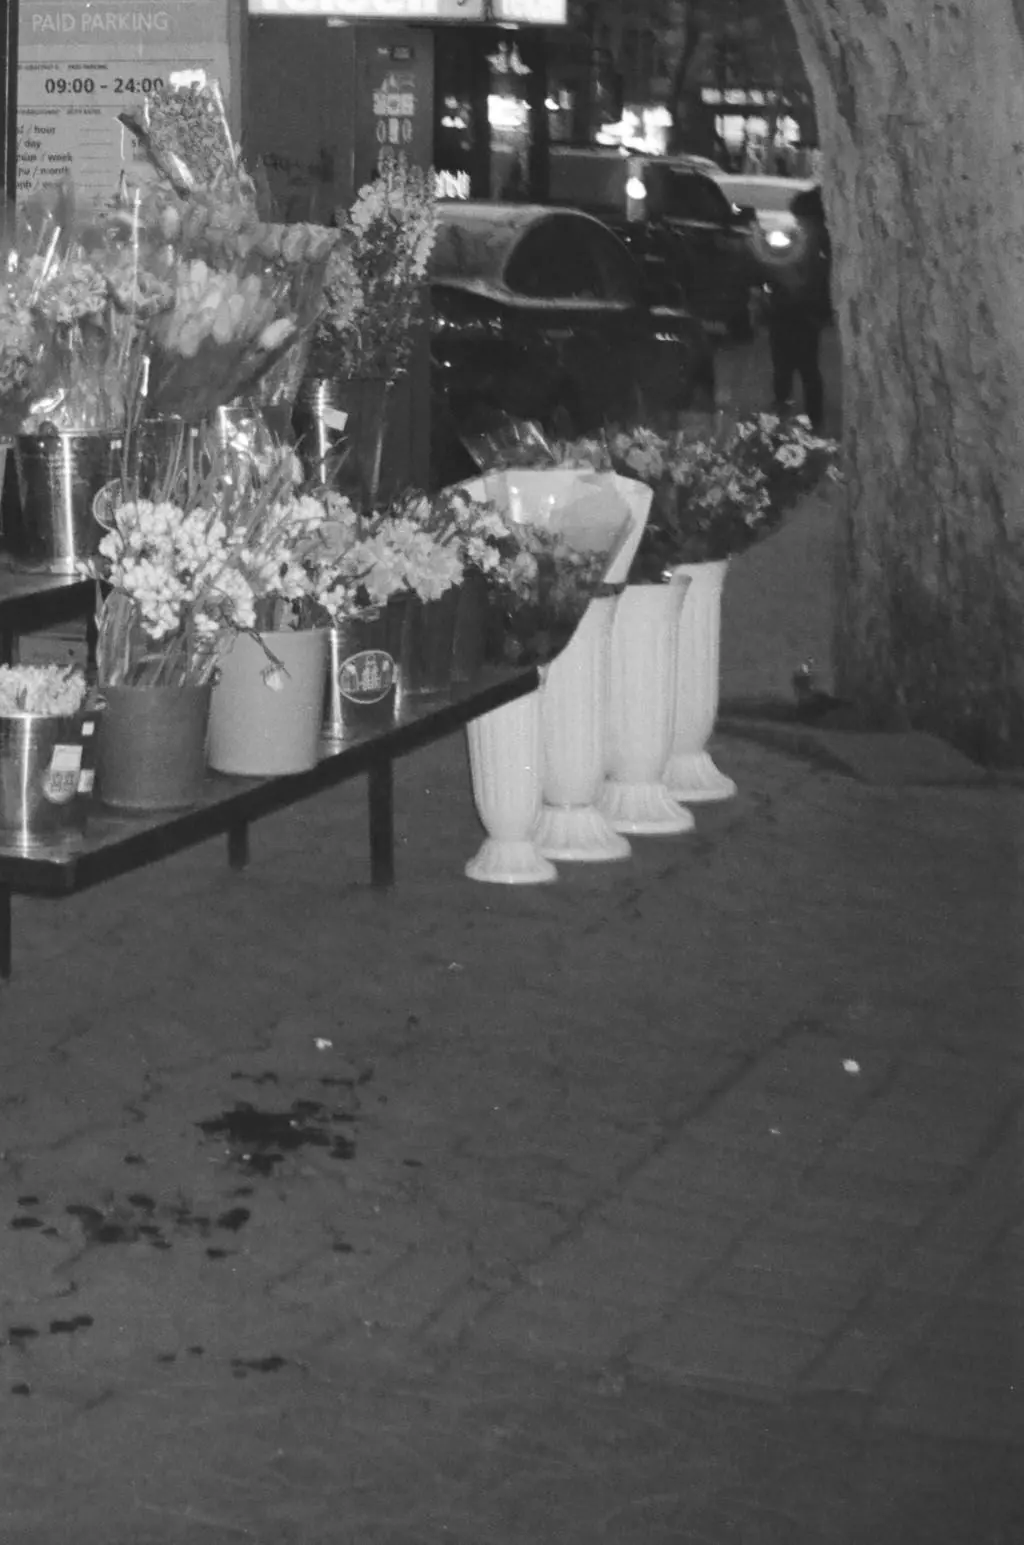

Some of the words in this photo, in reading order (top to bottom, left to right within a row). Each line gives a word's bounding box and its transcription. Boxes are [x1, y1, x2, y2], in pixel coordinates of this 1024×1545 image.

[32, 12, 75, 33] PAID
[81, 11, 169, 32] PARKING
[44, 77, 95, 94] 09:00
[114, 77, 164, 94] 24:00
